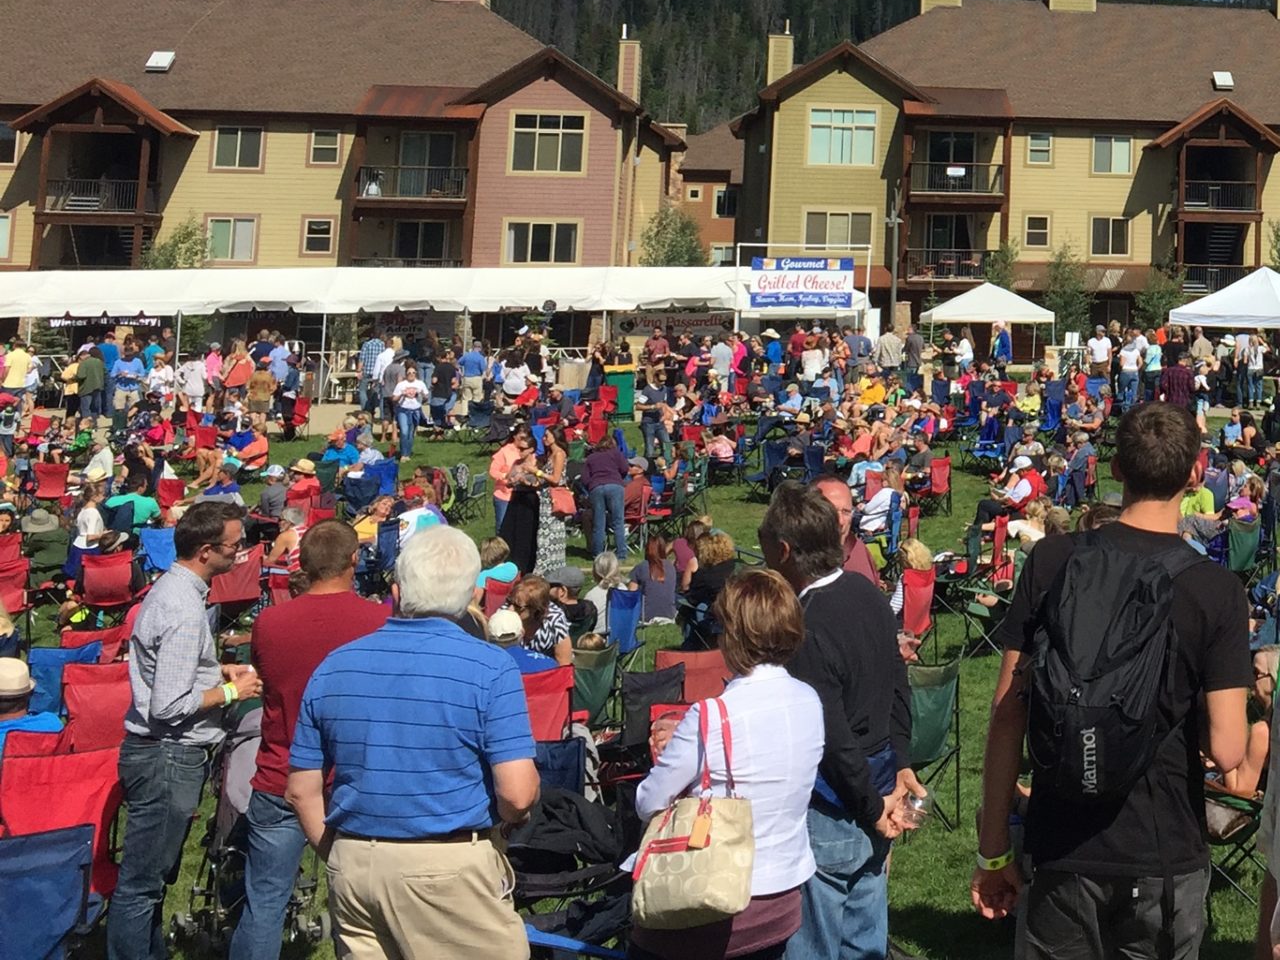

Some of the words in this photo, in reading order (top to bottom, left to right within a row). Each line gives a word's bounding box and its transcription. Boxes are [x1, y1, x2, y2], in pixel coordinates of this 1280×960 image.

[781, 258, 824, 270] Gourmet
[758, 274, 800, 294] Grilled
[803, 274, 847, 291] Cheese!
[49, 319, 87, 328] Winter
[633, 315, 662, 328] Vino
[1080, 727, 1097, 793] Marmot
